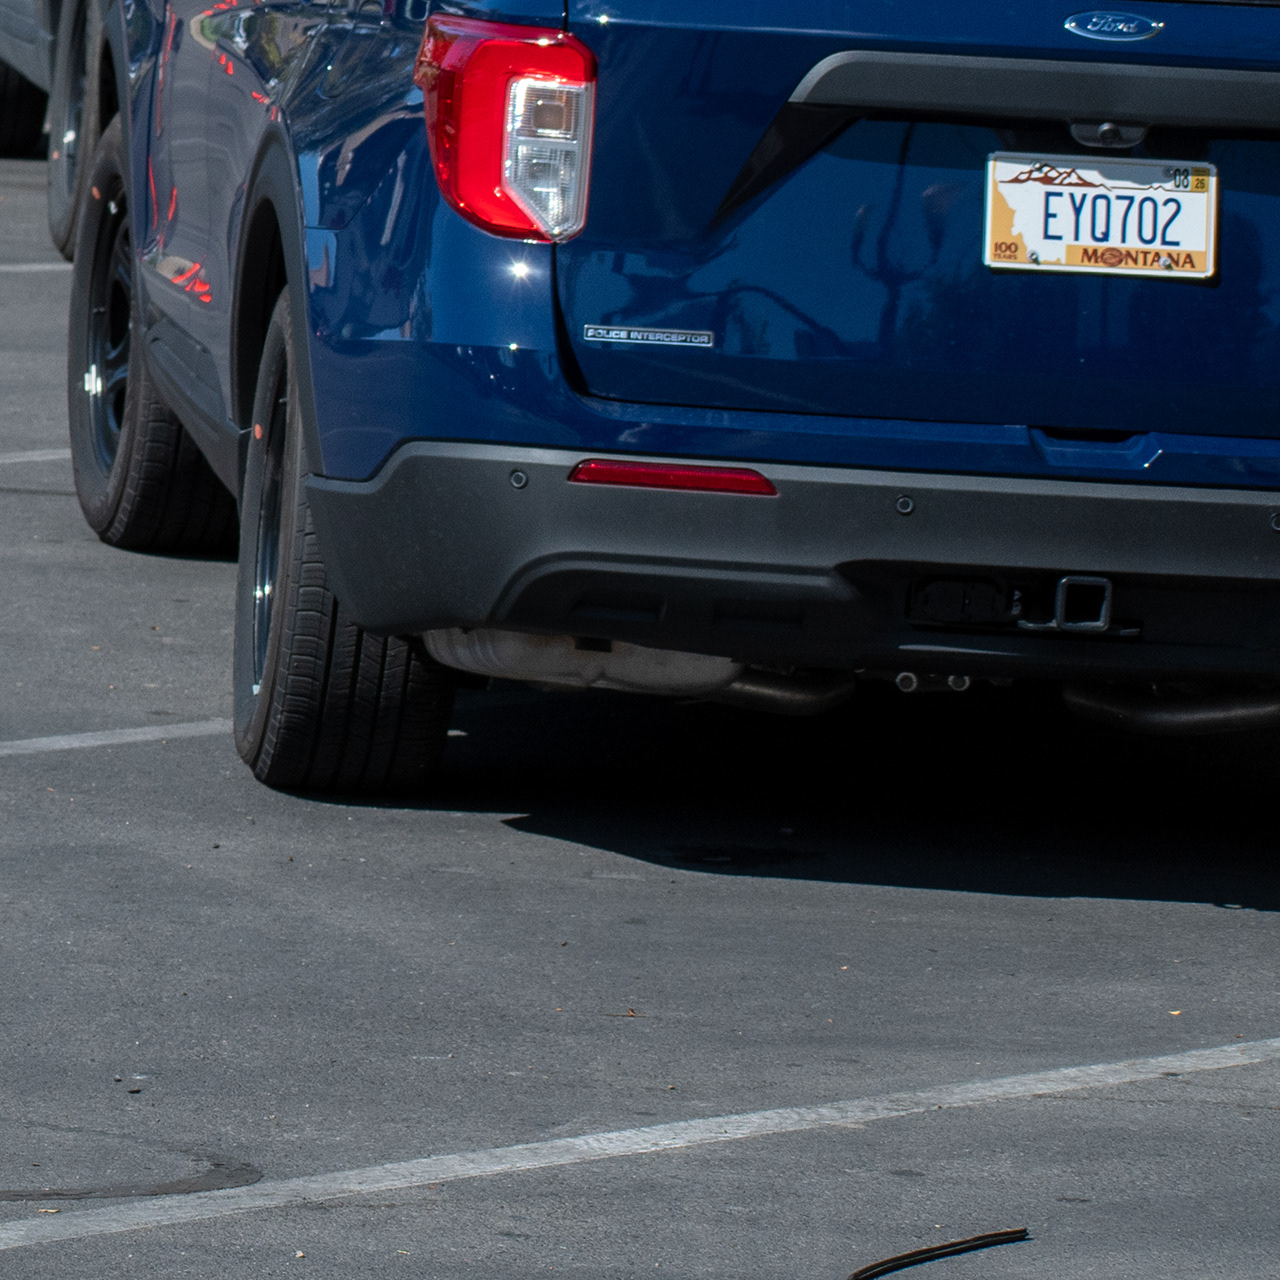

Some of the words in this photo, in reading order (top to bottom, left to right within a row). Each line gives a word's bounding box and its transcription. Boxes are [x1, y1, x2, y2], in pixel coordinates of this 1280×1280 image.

[1086, 15, 1139, 32] Ford
[1173, 168, 1189, 189] 08
[1194, 178, 1206, 190] 26
[1043, 191, 1182, 246] EYQ702
[993, 241, 1018, 254] 100
[587, 328, 628, 339] POLICE
[630, 331, 708, 343] INTERCEPTOR
